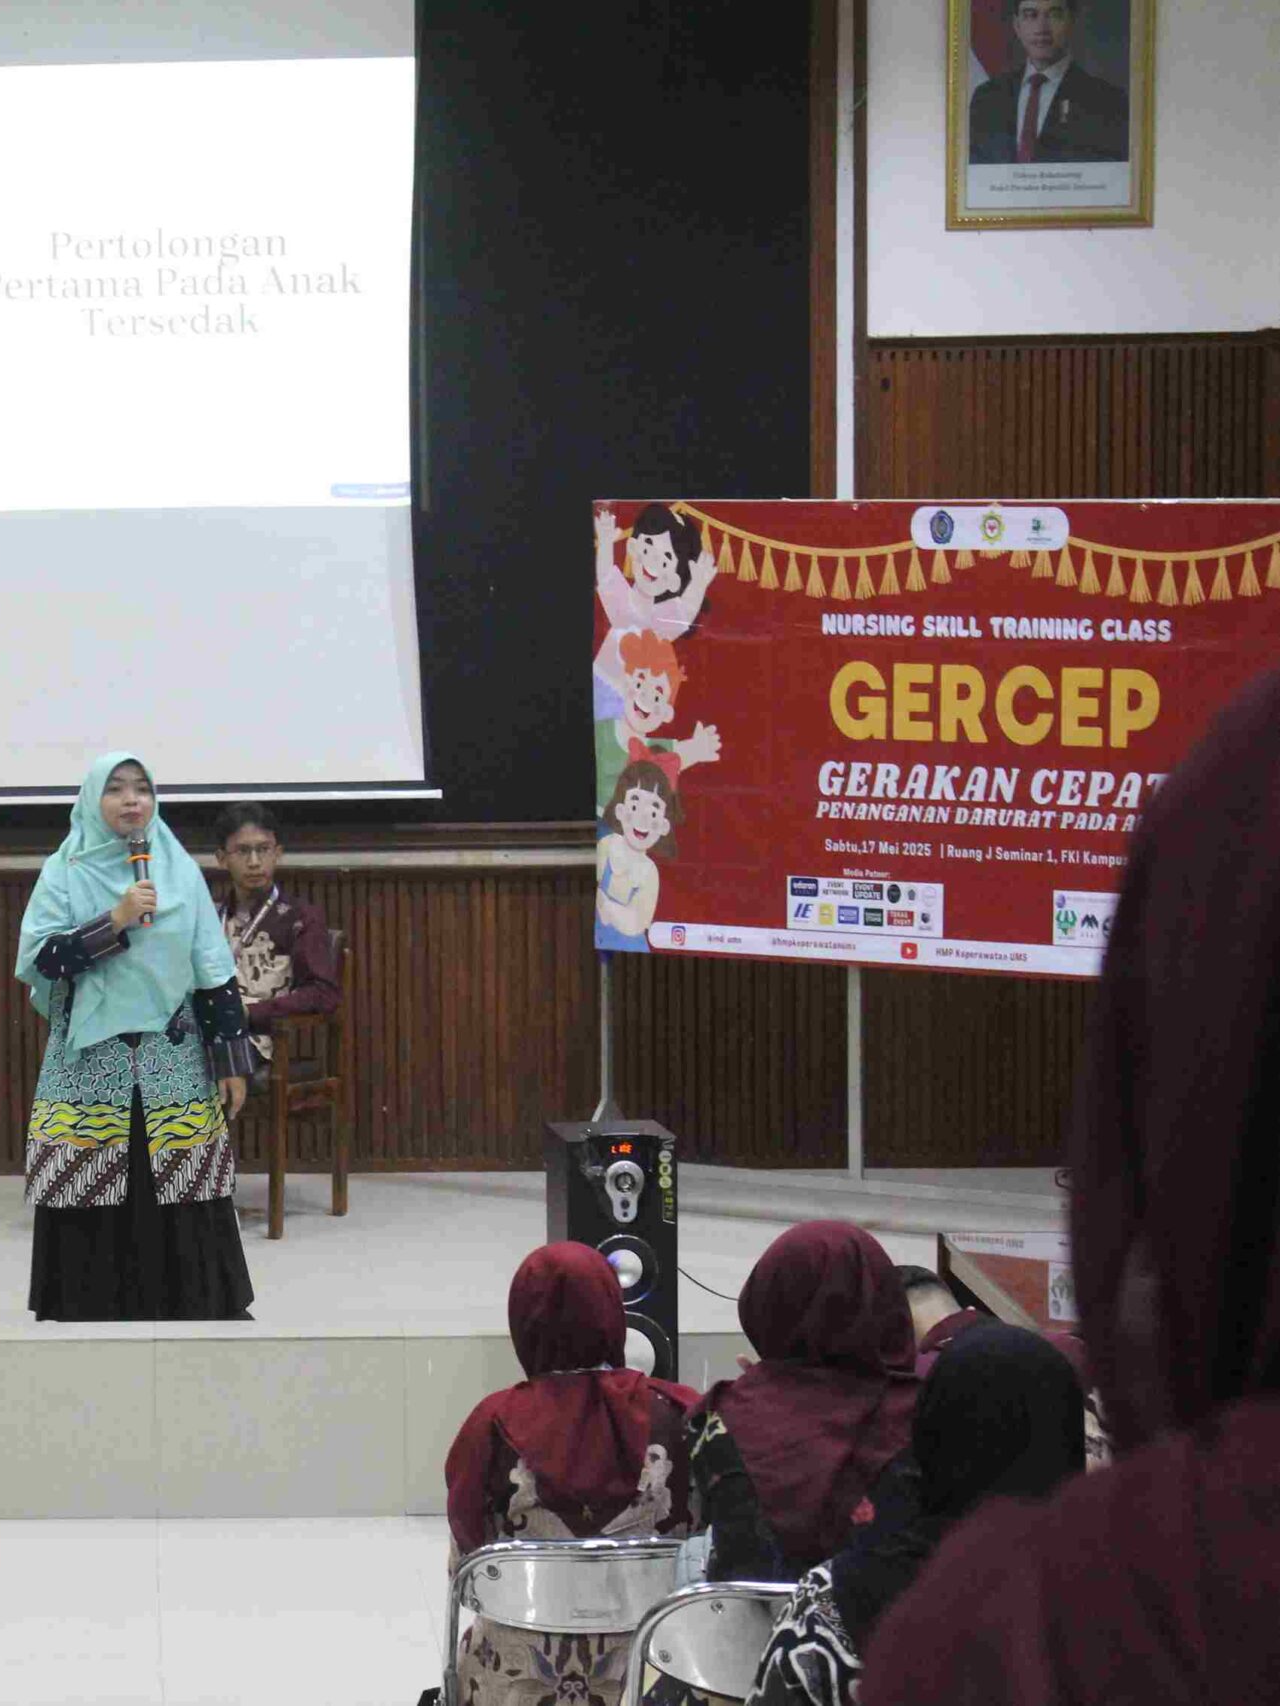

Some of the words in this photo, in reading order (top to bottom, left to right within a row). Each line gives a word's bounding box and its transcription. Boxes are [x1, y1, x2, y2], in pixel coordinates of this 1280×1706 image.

[51, 228, 287, 264] Pertolongan
[158, 265, 248, 296] Pada
[261, 263, 362, 295] Anak
[81, 303, 259, 336] Tersedak
[822, 613, 916, 636] NURSING
[922, 615, 982, 638] SKILL
[990, 616, 1093, 641] TRAINING
[1100, 619, 1171, 642] CLASS
[829, 660, 1160, 748] GERCEP
[818, 760, 1020, 803] GERAKAN
[815, 800, 950, 824] PENANGANAN
[954, 806, 1056, 829] DARURAT
[1060, 811, 1116, 832] PADA
[879, 841, 899, 855] Mei
[902, 842, 932, 857] 2025
[946, 844, 983, 861] Ruang
[985, 846, 993, 859] J
[995, 846, 1043, 863] Seminar
[1046, 849, 1058, 864] 1,
[1061, 850, 1079, 863] FKI
[843, 868, 864, 877] Media
[854, 891, 881, 900] UPDATE
[936, 947, 954, 957] HMP
